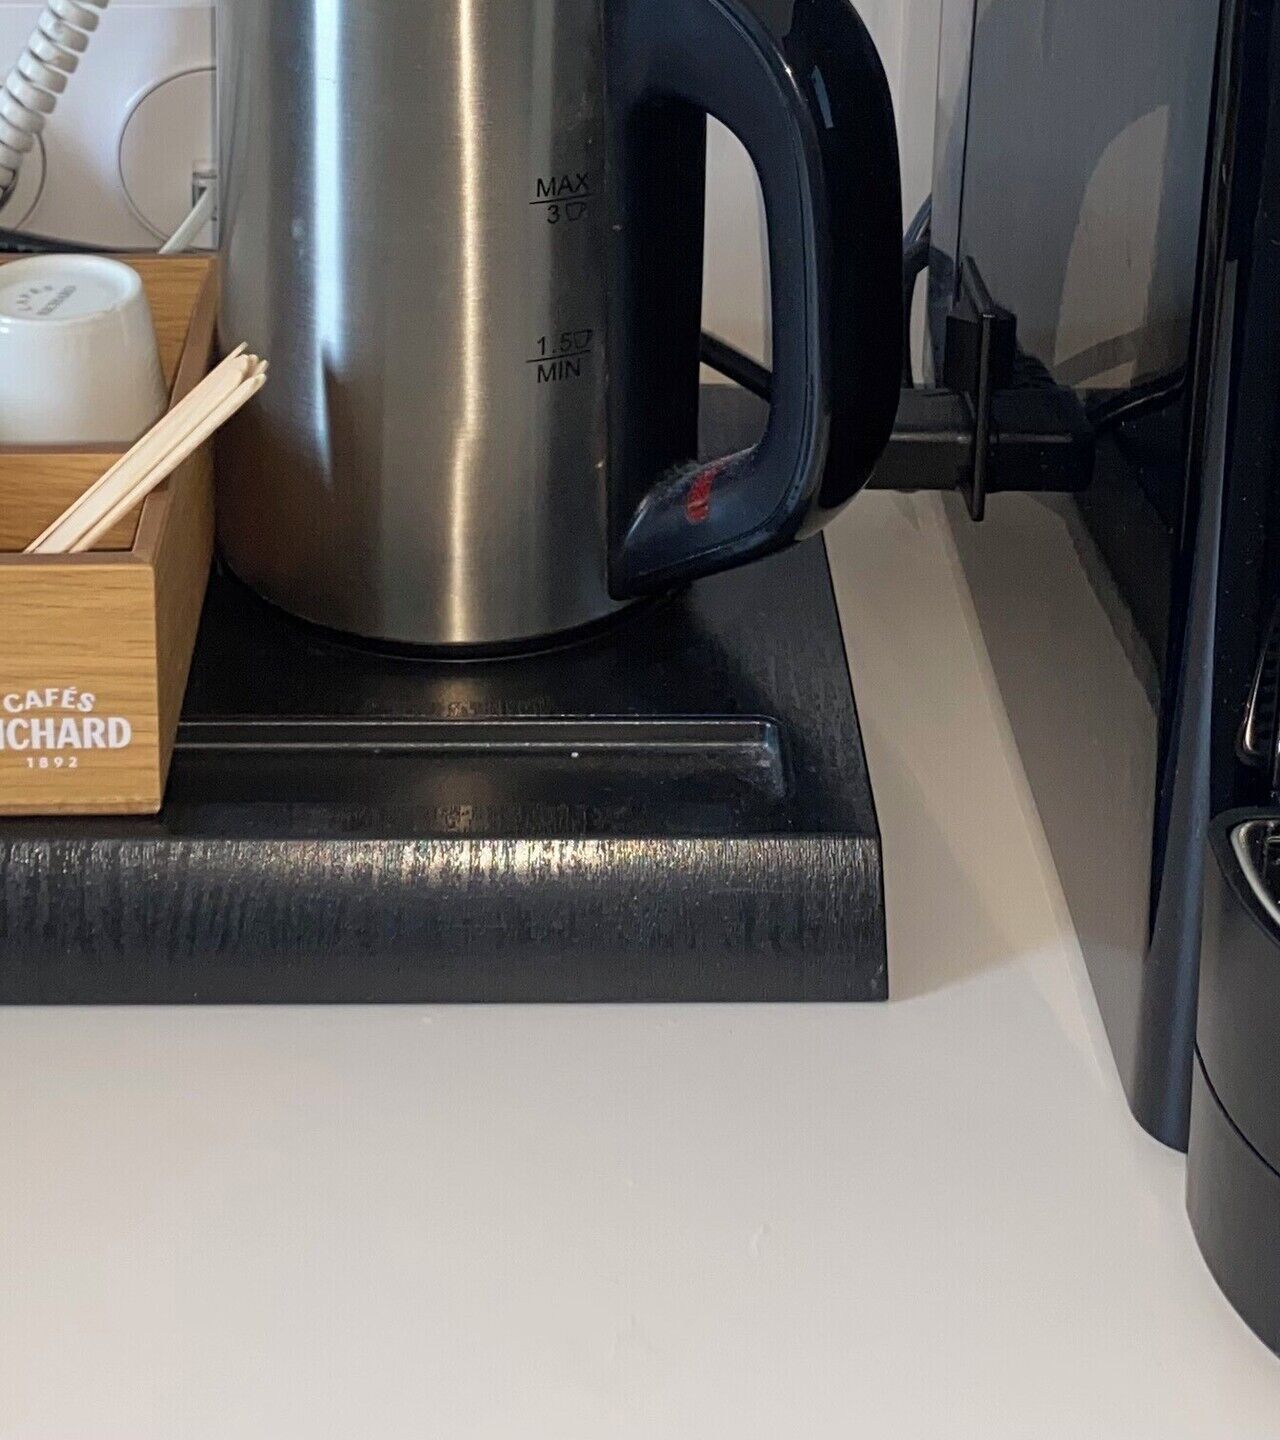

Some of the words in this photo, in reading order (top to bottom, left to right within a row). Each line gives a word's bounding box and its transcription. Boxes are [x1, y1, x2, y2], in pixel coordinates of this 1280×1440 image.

[536, 172, 590, 198] MAX
[536, 358, 582, 384] MIN
[2, 686, 96, 713] CAFÉS
[26, 756, 79, 769] 1892
